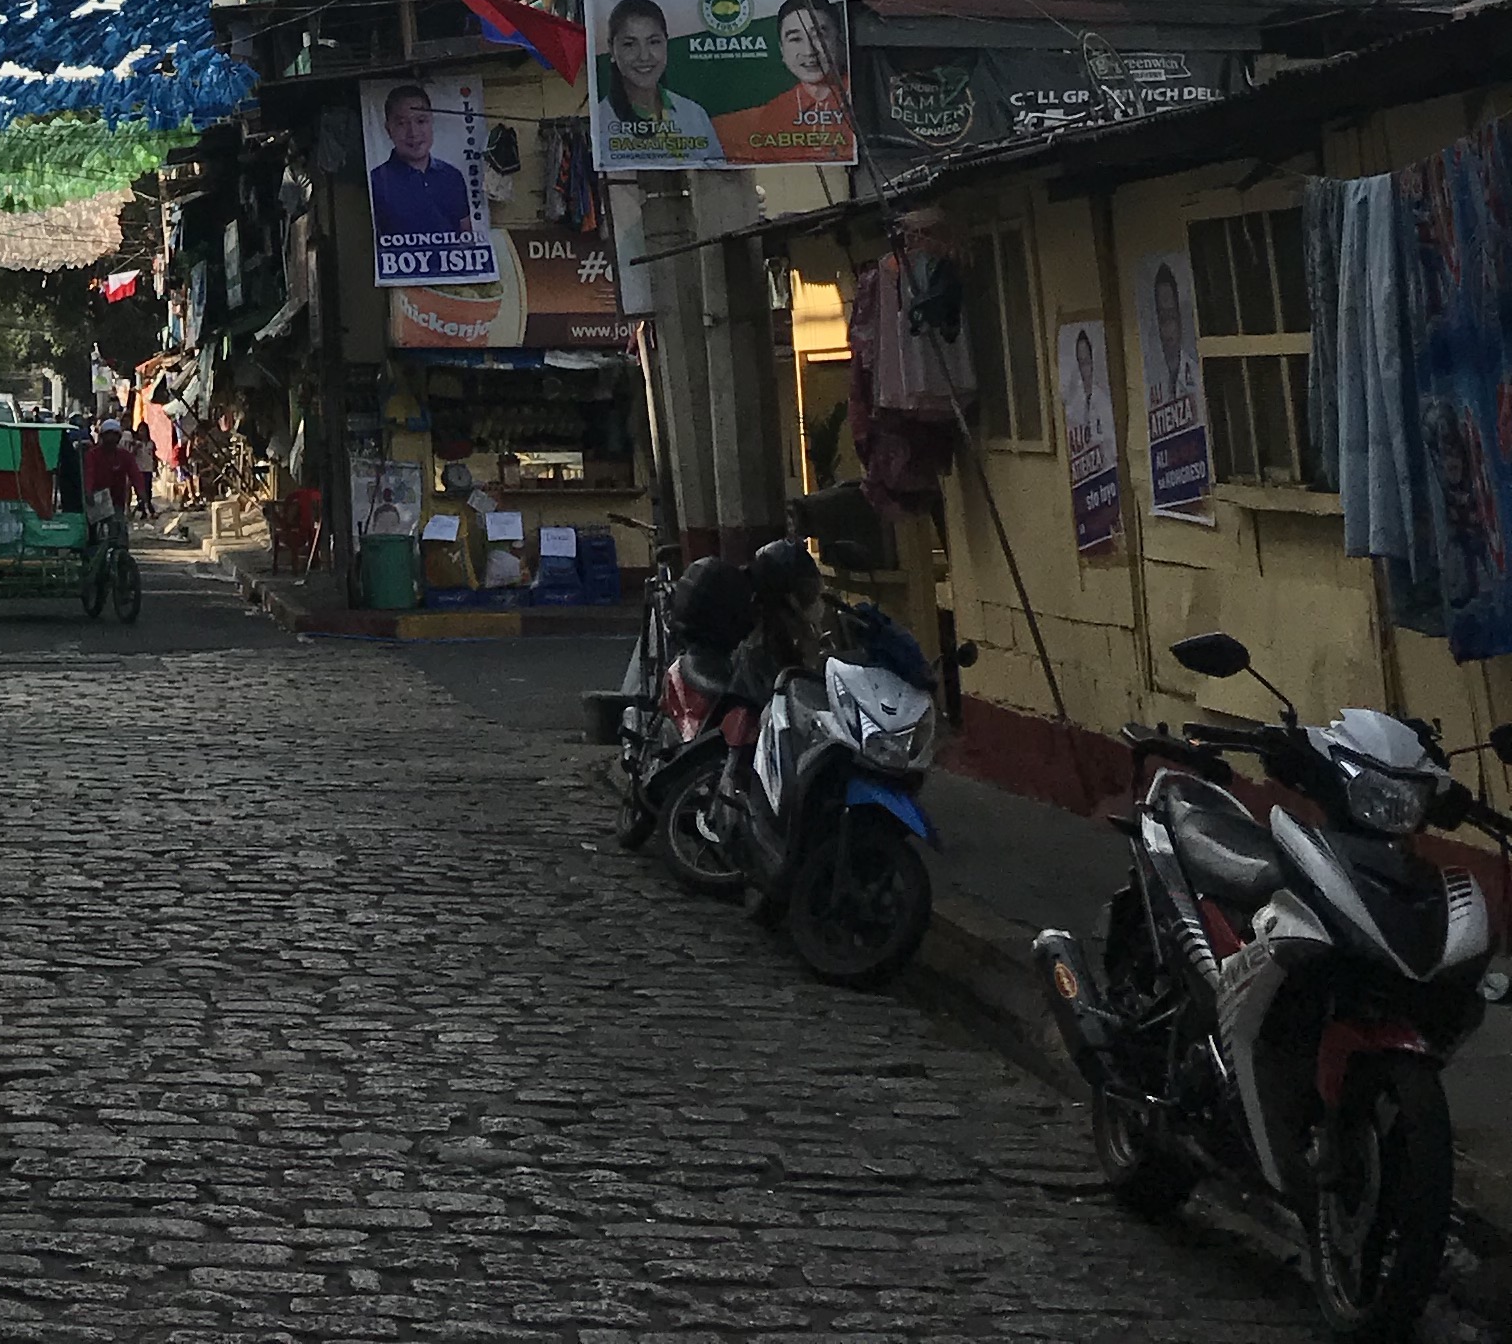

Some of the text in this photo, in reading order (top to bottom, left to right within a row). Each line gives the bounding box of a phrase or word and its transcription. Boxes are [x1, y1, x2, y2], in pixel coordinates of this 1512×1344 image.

[689, 36, 768, 52] KABAKA
[793, 111, 844, 126] JOEY
[890, 102, 977, 125] DELIVERY
[608, 120, 682, 134] CRISTAL
[609, 137, 709, 151] BAGATSING
[749, 131, 847, 148] CABREZA
[380, 231, 488, 247] COUNCILOR
[528, 240, 577, 260] DIAL
[381, 249, 490, 274] BOY ISIP
